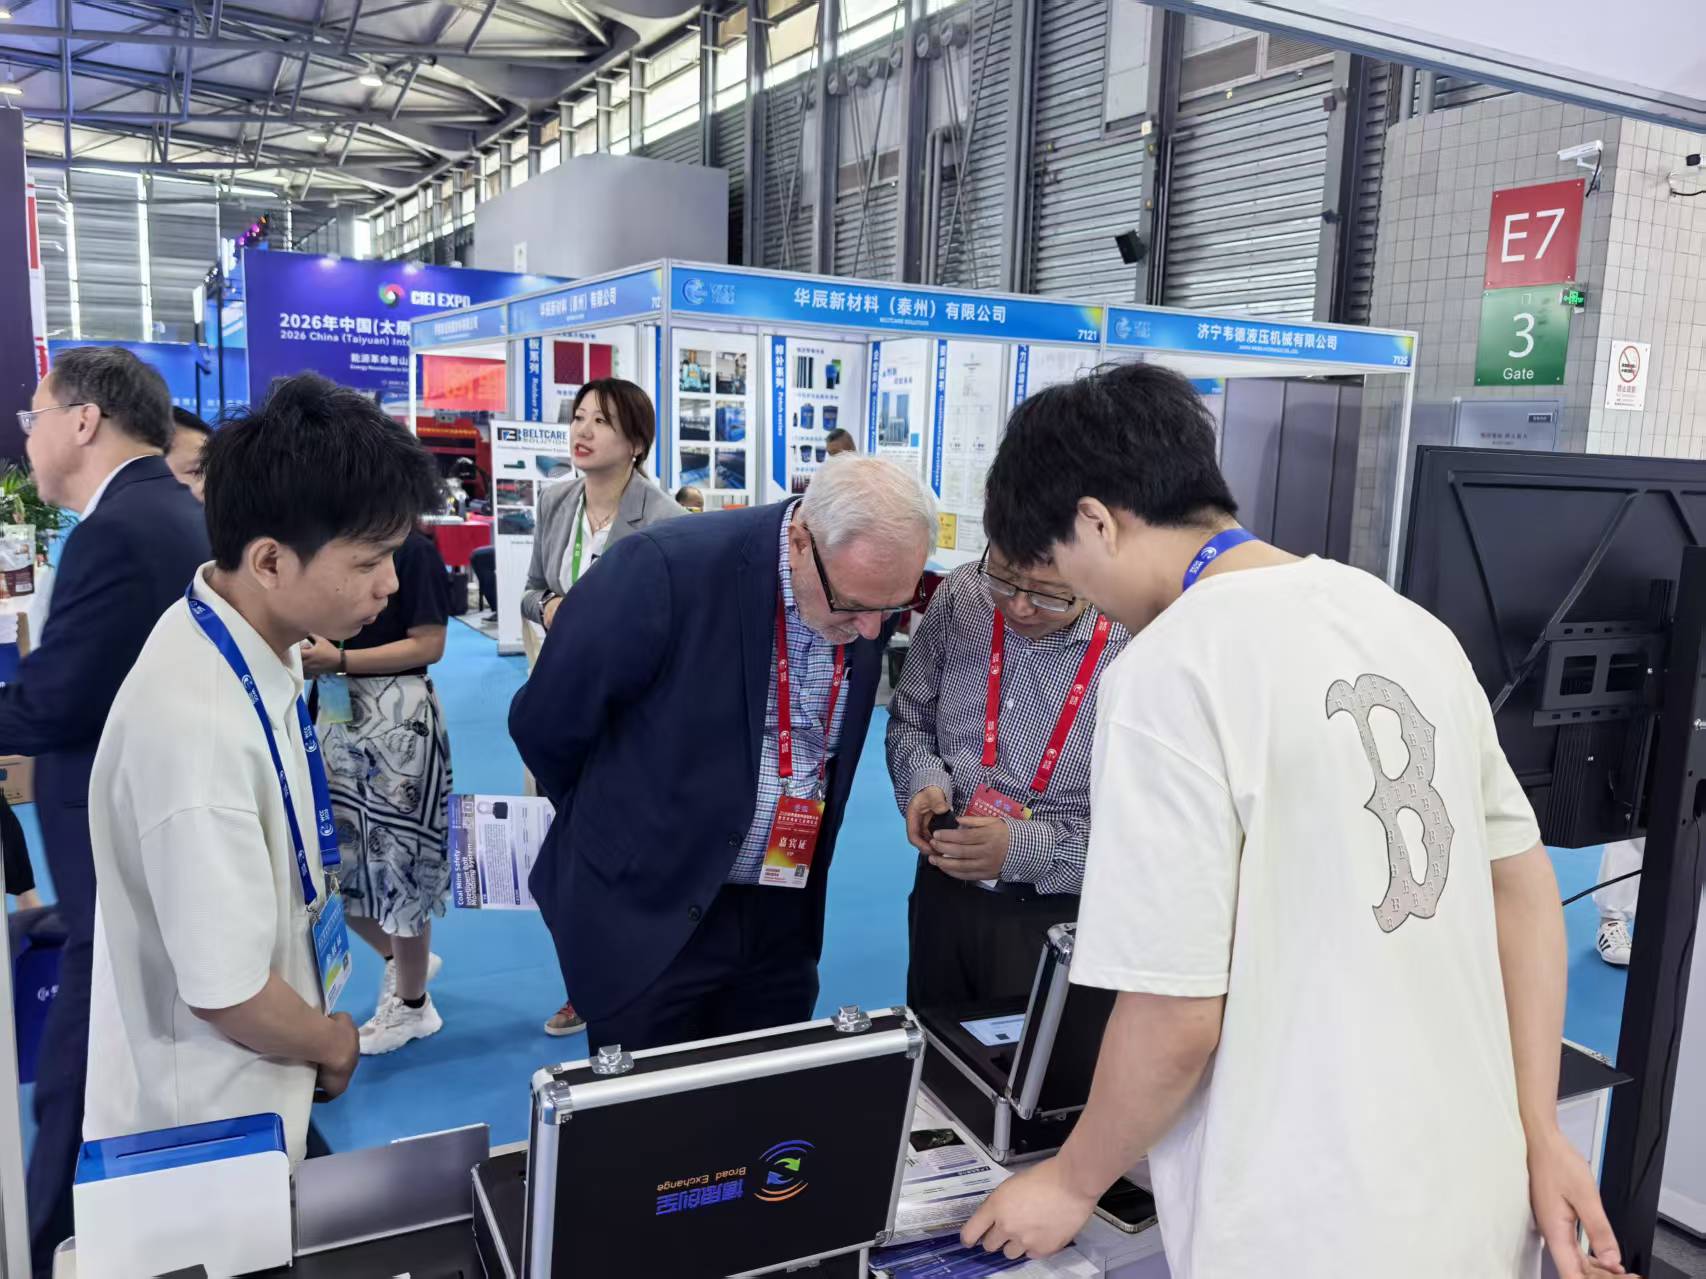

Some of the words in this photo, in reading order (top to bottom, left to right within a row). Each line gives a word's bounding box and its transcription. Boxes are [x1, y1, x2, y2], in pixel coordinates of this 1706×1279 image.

[1501, 207, 1566, 263] E7
[437, 292, 471, 308] EXPO
[280, 330, 307, 340] 2026
[309, 331, 340, 343] China
[342, 333, 389, 346] (Taiyuan)
[1077, 328, 1097, 340] 7121
[1508, 313, 1535, 358] 3
[1392, 355, 1409, 366] 7125
[1503, 368, 1534, 380] Gate
[522, 429, 568, 440] BELTCARE
[456, 890, 465, 905] Coal
[716, 1167, 747, 1181] Broad
[657, 1175, 709, 1191] Exchange
